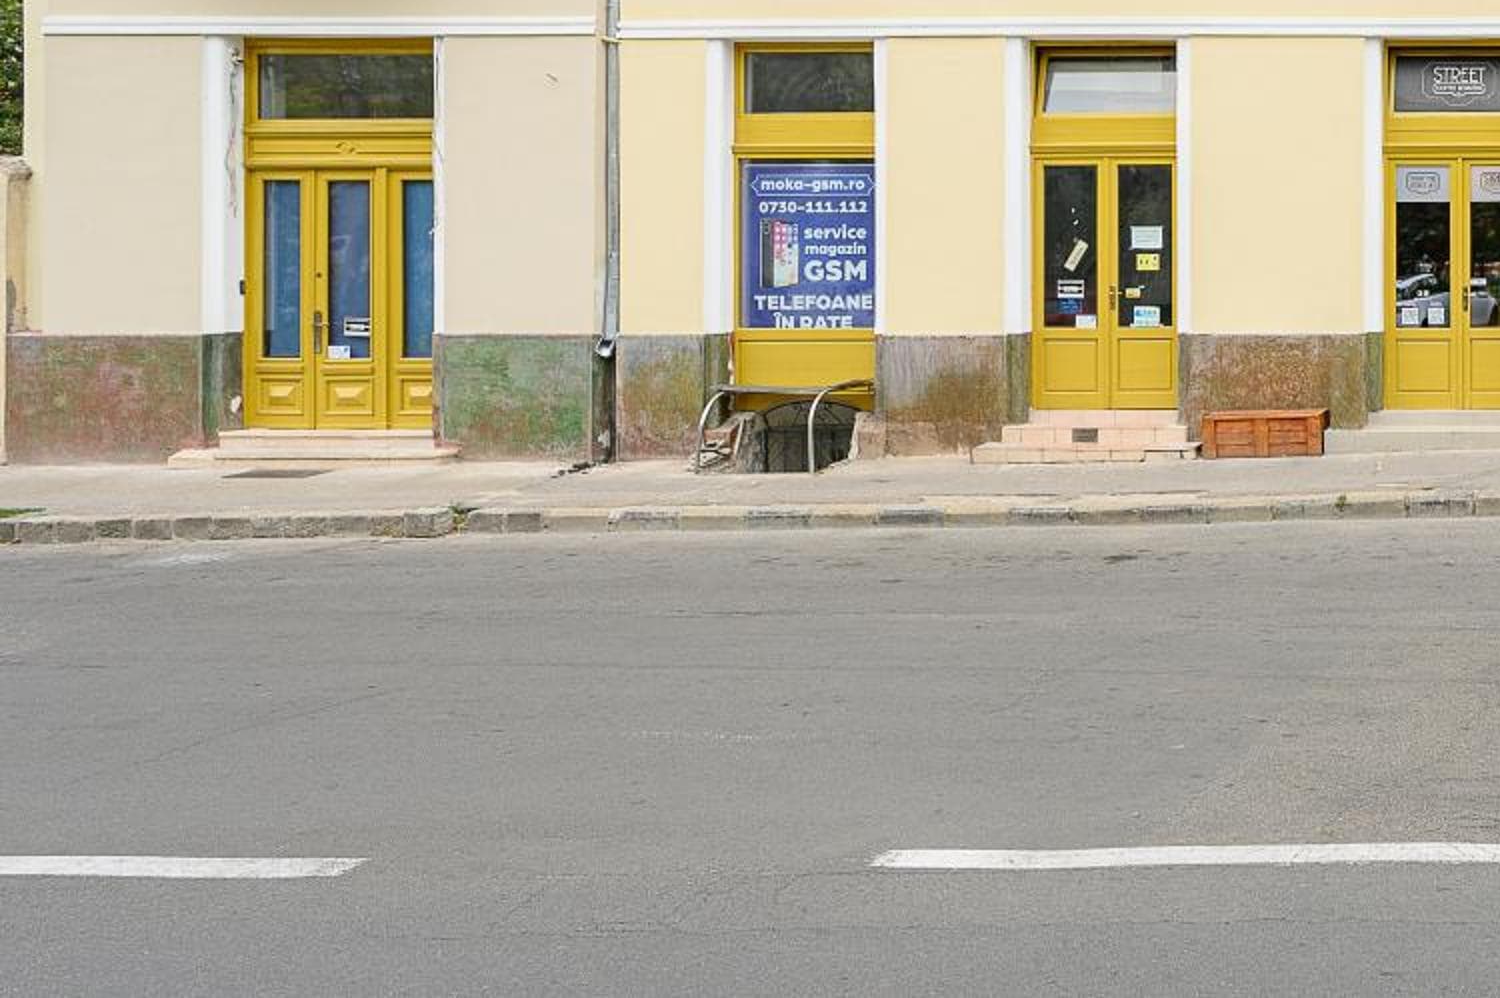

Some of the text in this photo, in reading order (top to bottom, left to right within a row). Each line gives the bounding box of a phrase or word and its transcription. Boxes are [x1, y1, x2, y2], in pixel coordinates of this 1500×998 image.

[1433, 66, 1486, 83] STREET
[760, 178, 865, 193] moka-gsm.ro
[803, 223, 867, 240] service
[804, 241, 867, 257] magazin
[803, 259, 867, 282] GSM
[754, 294, 873, 311] TELEFOANE
[799, 315, 853, 329] RATE
